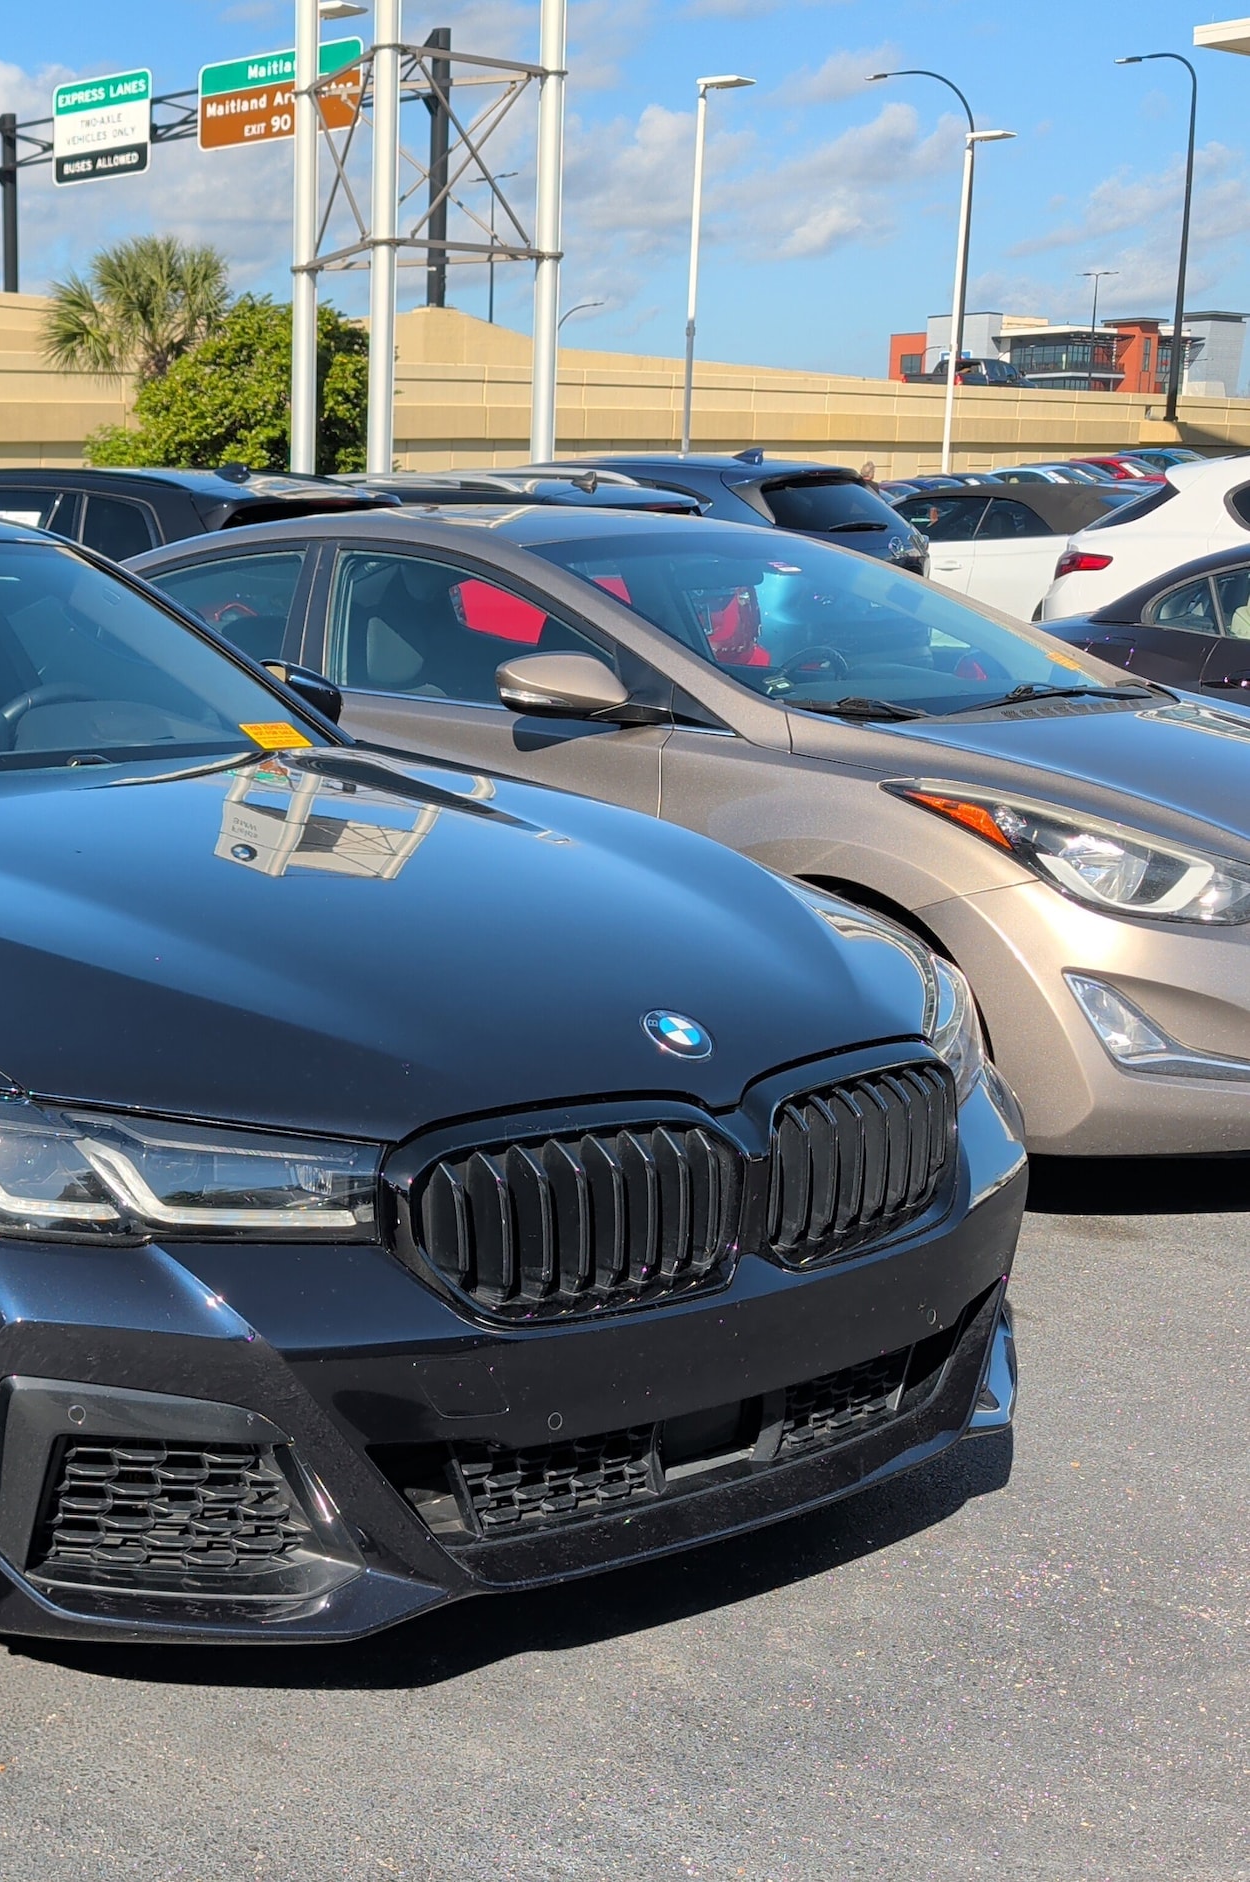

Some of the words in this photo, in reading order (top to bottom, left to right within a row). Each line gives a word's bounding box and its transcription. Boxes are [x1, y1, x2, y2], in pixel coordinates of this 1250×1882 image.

[248, 59, 296, 80] Maitla
[58, 87, 105, 108] EXPRESS
[110, 79, 146, 98] LANES
[206, 94, 267, 118] Maitland
[66, 130, 107, 146] VEHICLES
[112, 126, 136, 138] ONLY
[244, 122, 267, 137] EXIT
[271, 114, 292, 133] 90
[63, 158, 93, 175] BUSES
[96, 151, 139, 169] ALLOWED
